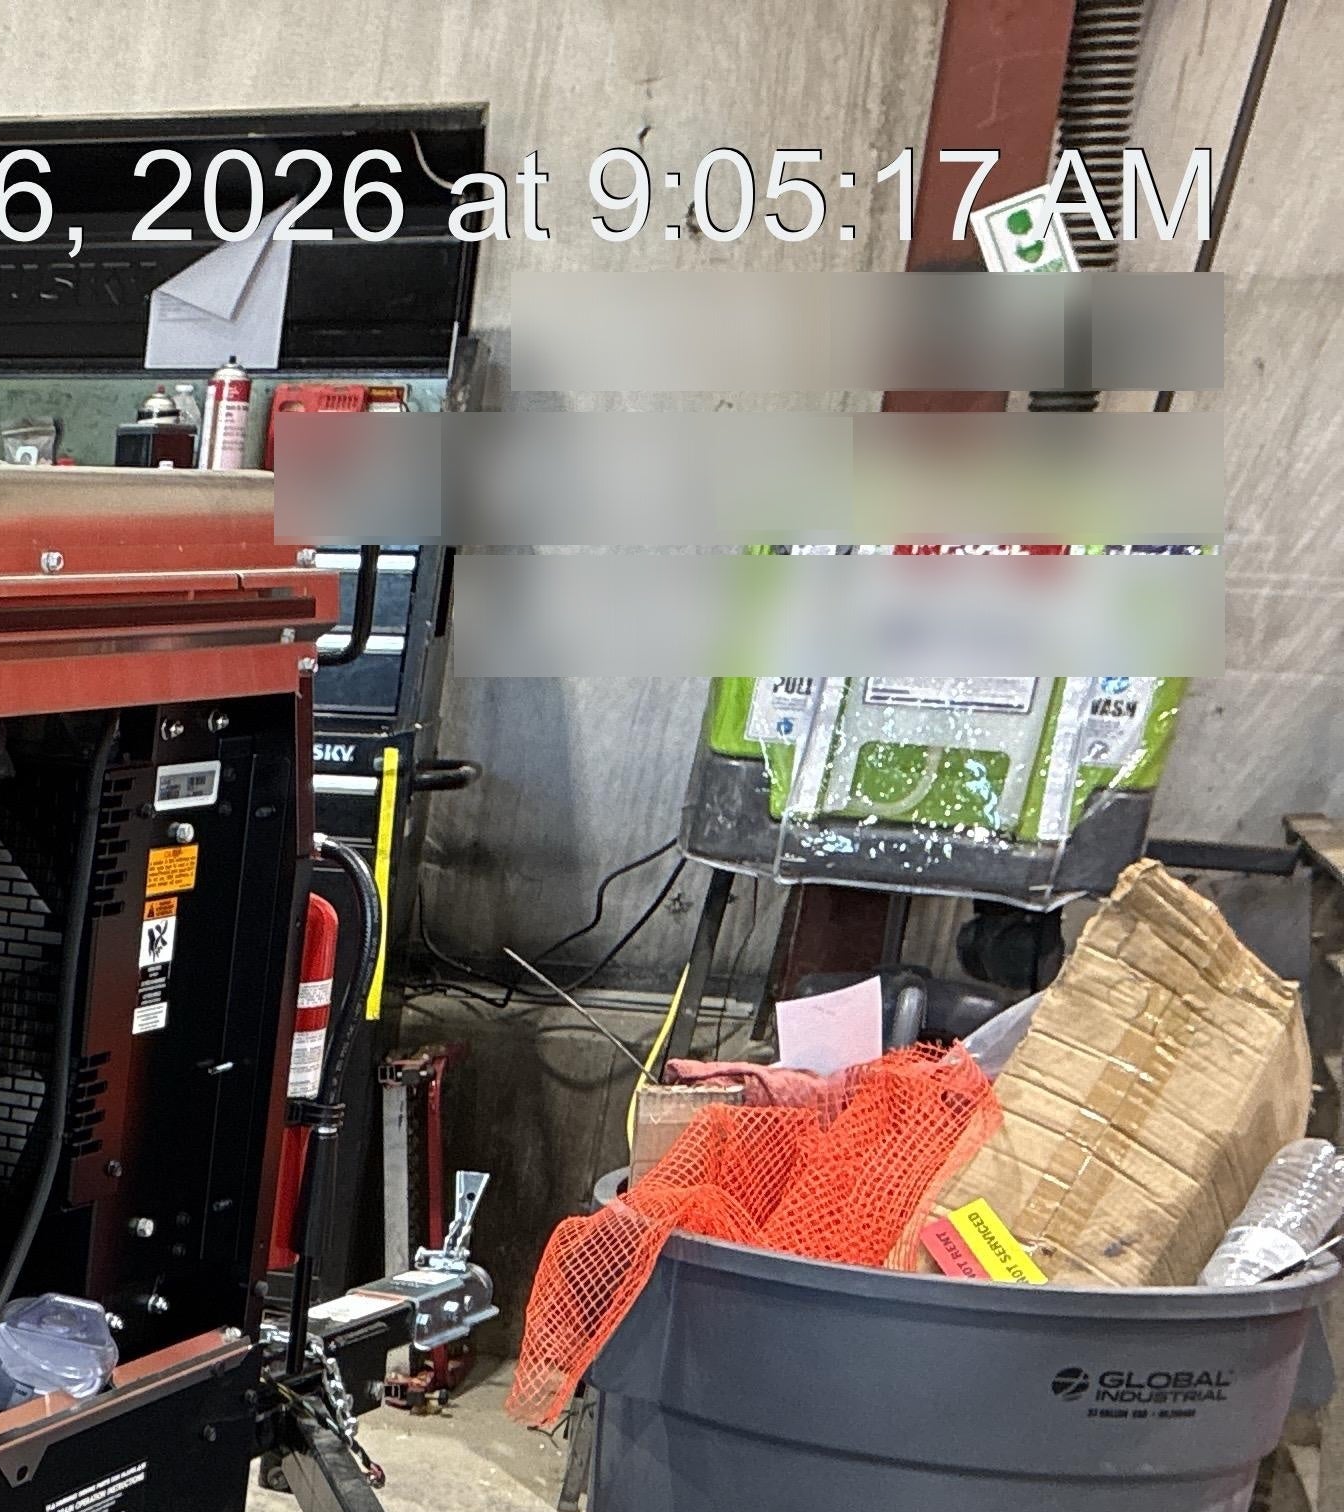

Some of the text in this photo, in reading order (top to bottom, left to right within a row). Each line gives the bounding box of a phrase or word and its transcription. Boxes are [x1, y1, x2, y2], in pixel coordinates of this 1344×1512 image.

[935, 1231, 962, 1260] RENT
[967, 1211, 1011, 1264] SERVICED
[1098, 1370, 1231, 1389] GLOBAL
[1095, 1389, 1228, 1402] INDUSTRIAL
